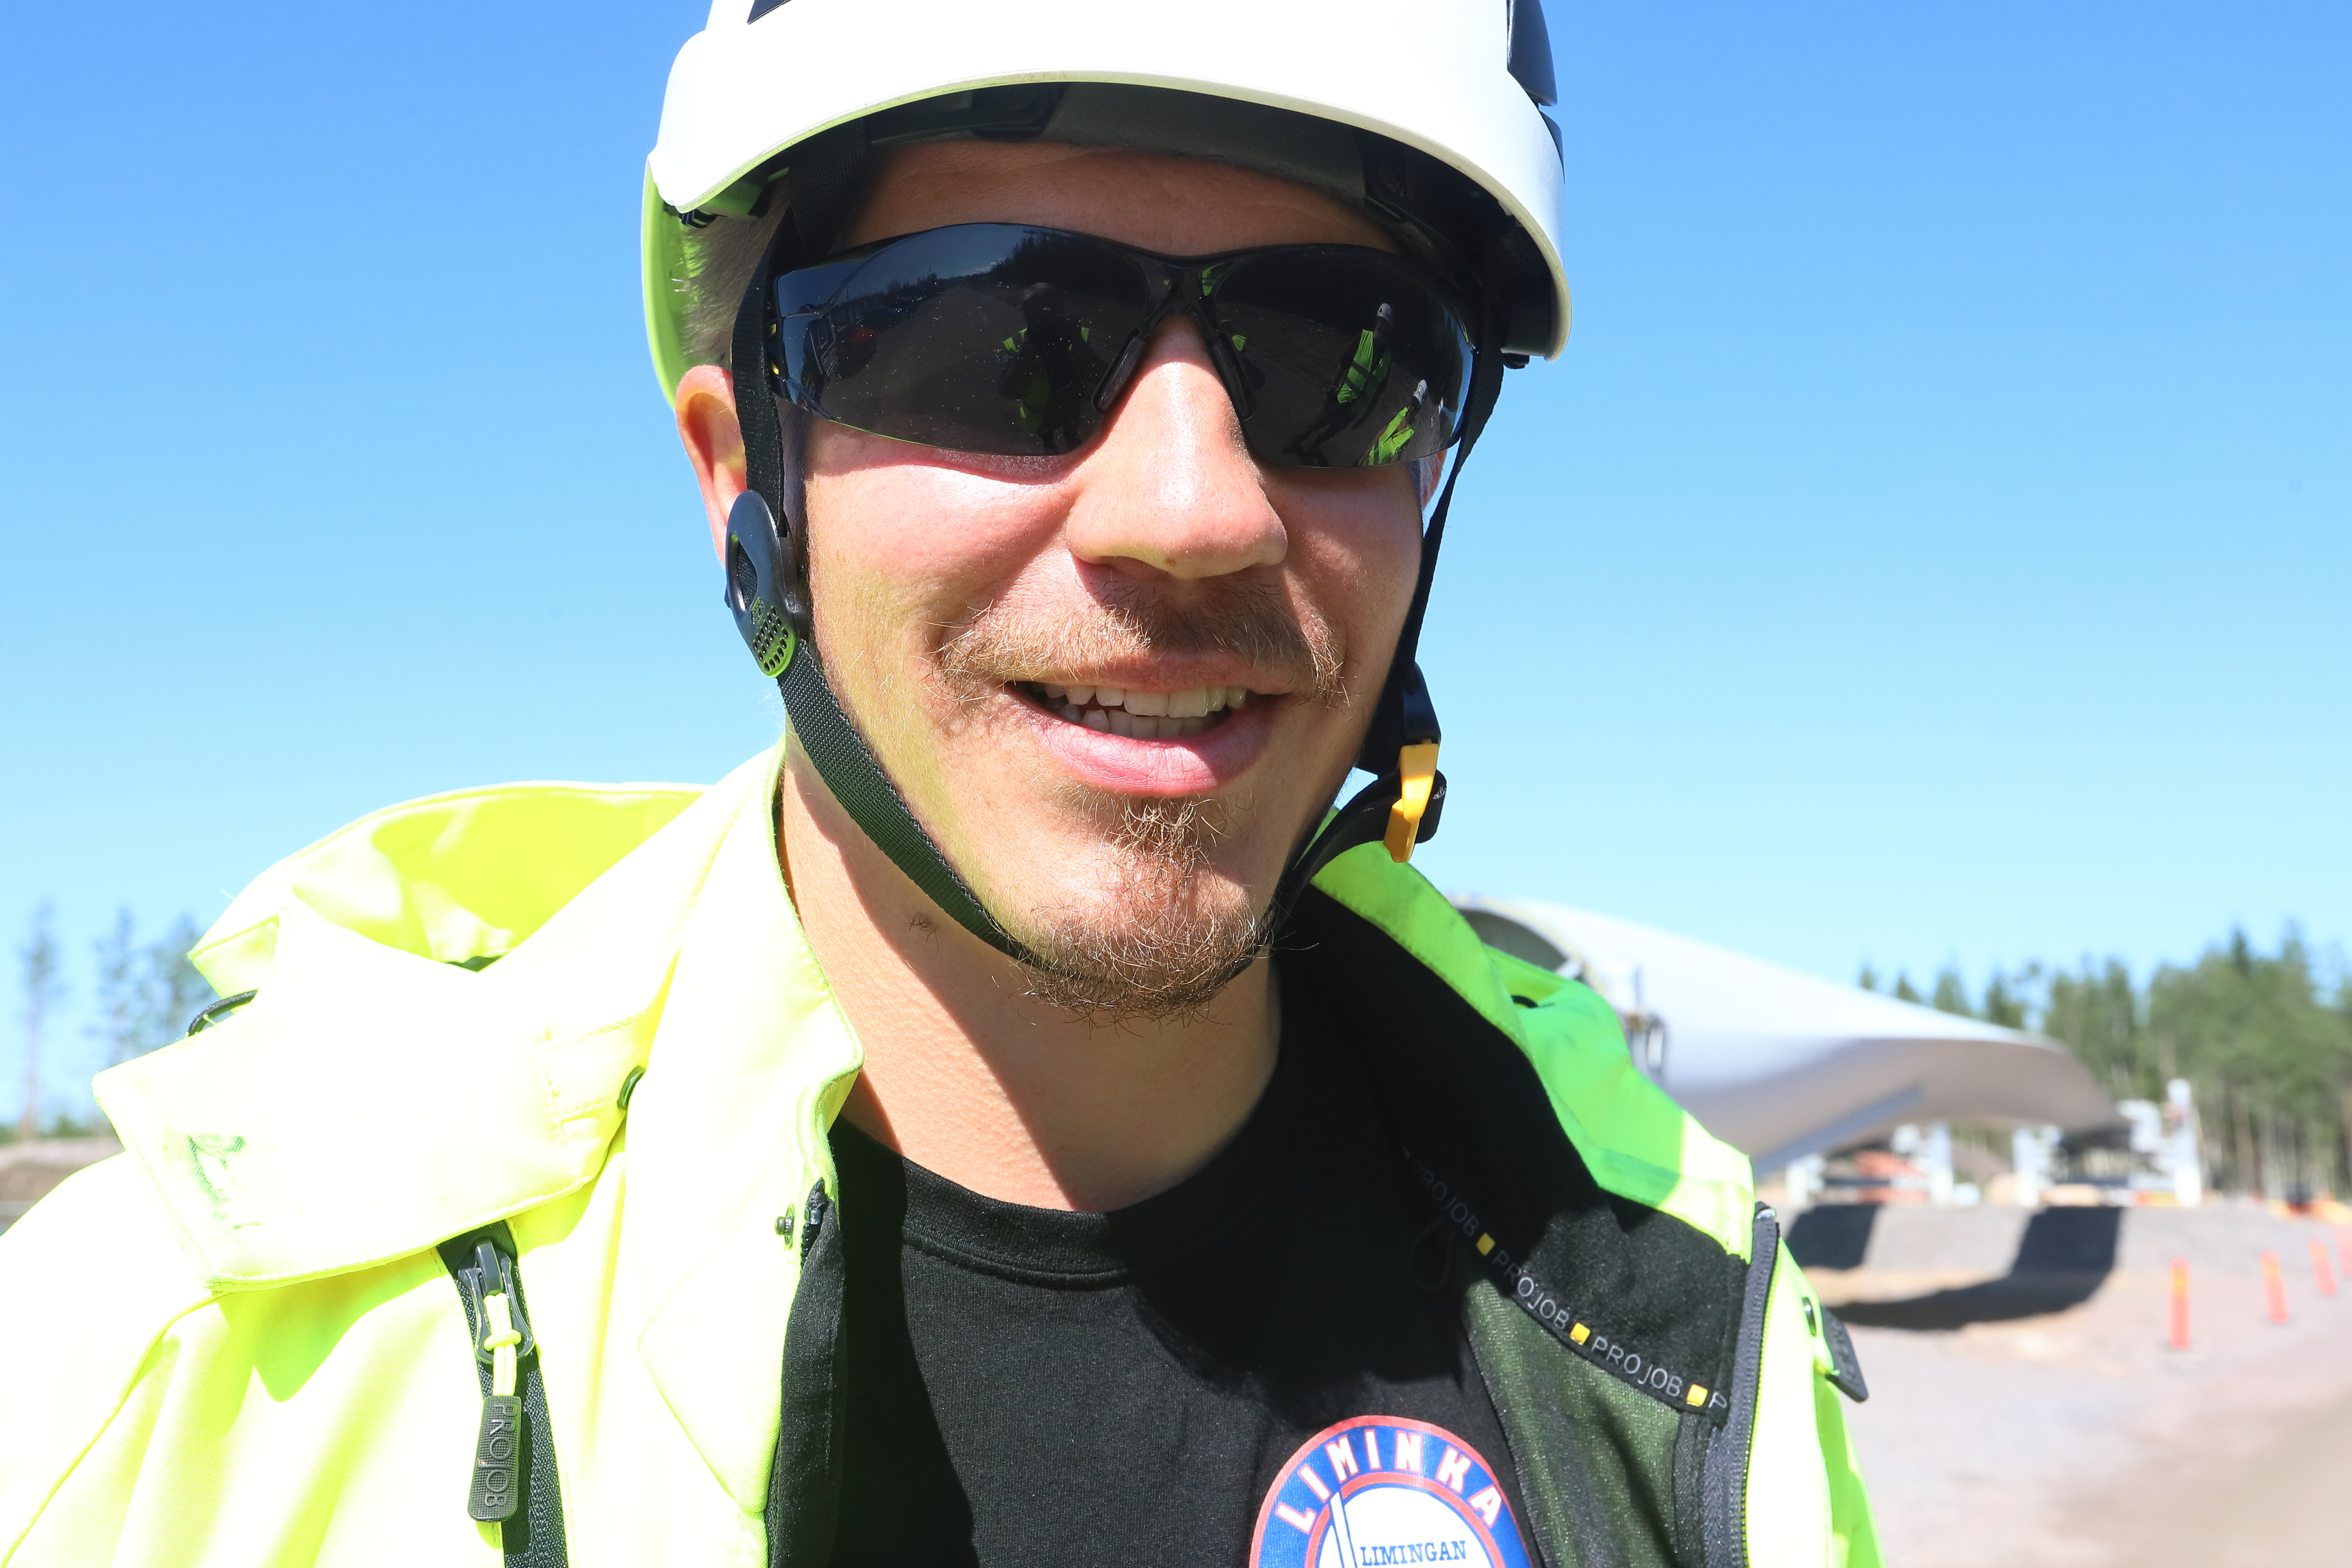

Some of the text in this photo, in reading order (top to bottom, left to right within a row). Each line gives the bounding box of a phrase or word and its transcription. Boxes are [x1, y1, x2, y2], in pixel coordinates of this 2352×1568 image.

[1412, 1159, 1479, 1237] PROJOB
[1492, 1250, 1570, 1330] PROJOB
[1591, 1336, 1683, 1397] PROJOB
[476, 1404, 517, 1507] PROJOB
[1275, 1429, 1502, 1534] LIMINKA
[1360, 1540, 1466, 1566] LIMINGAN
